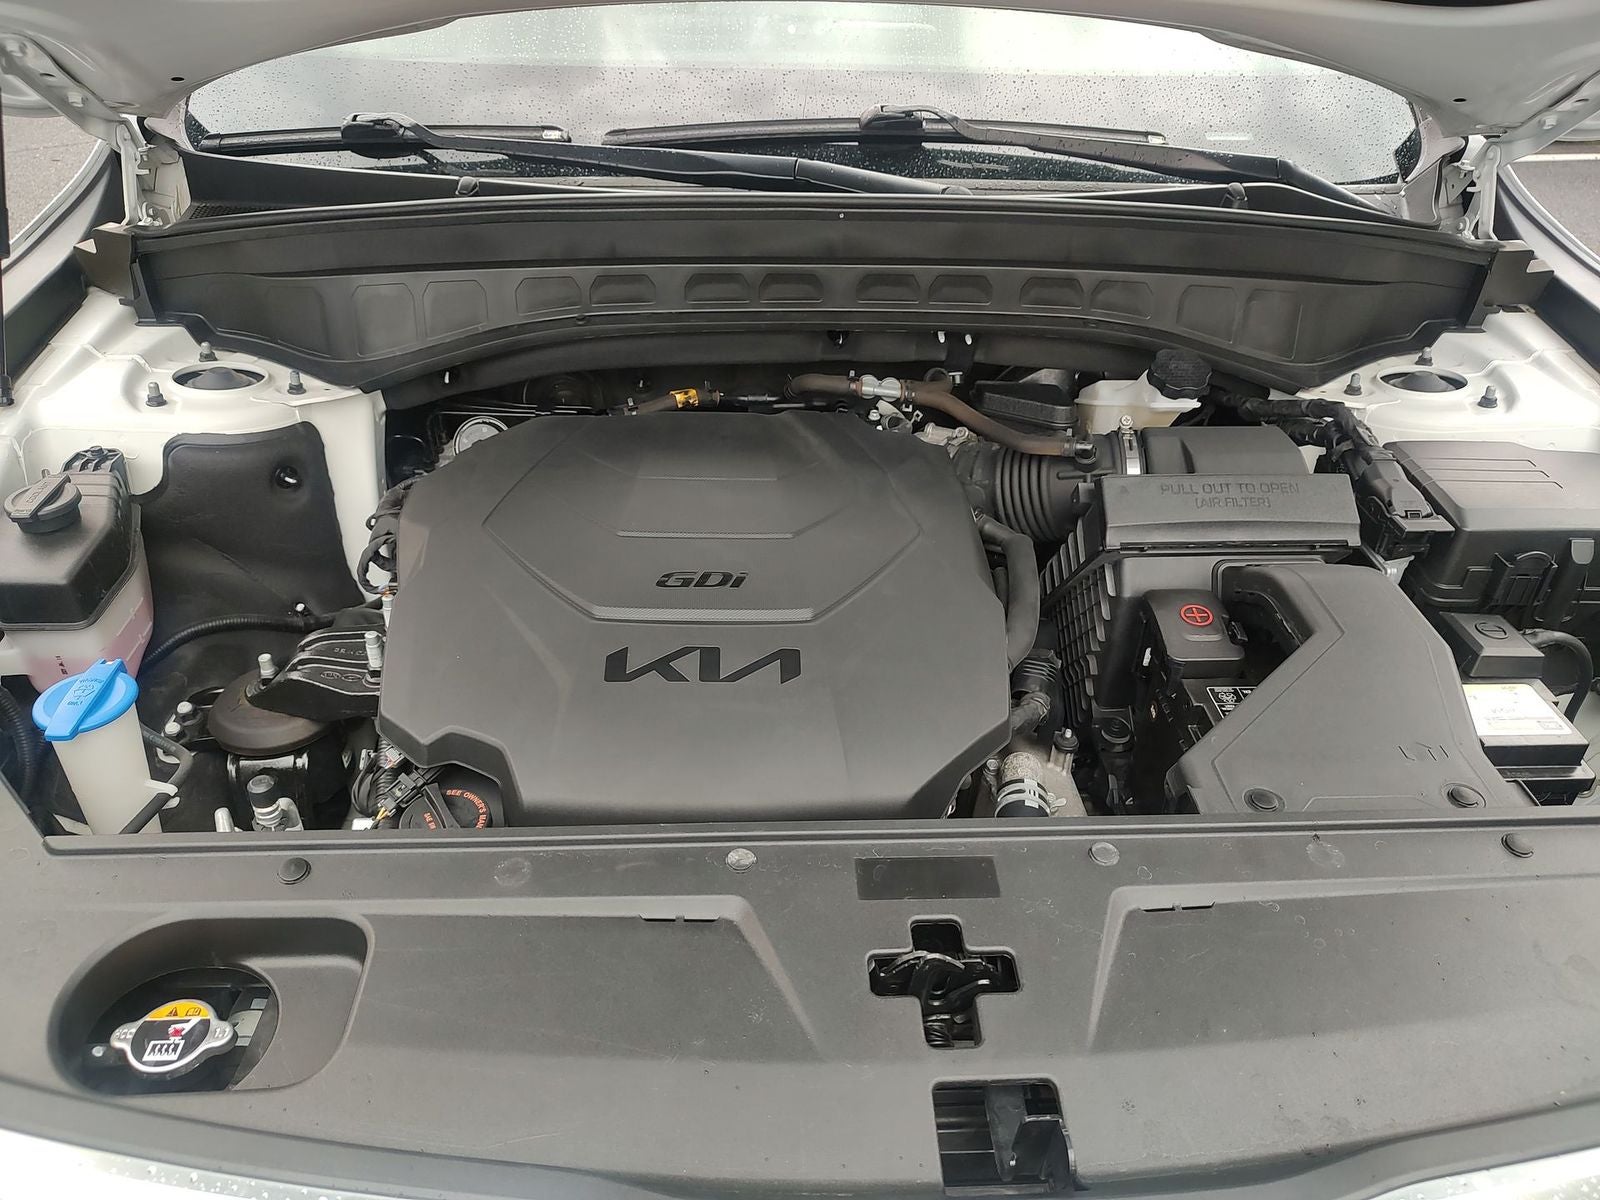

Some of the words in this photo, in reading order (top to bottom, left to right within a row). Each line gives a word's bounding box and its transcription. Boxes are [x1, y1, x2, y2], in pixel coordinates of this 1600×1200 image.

[1161, 483, 1199, 495] PULL
[1202, 483, 1231, 494] OUT
[1237, 483, 1255, 494] TO
[1260, 483, 1299, 494] OPEN
[655, 571, 748, 588] GDi
[604, 646, 801, 684] KIA
